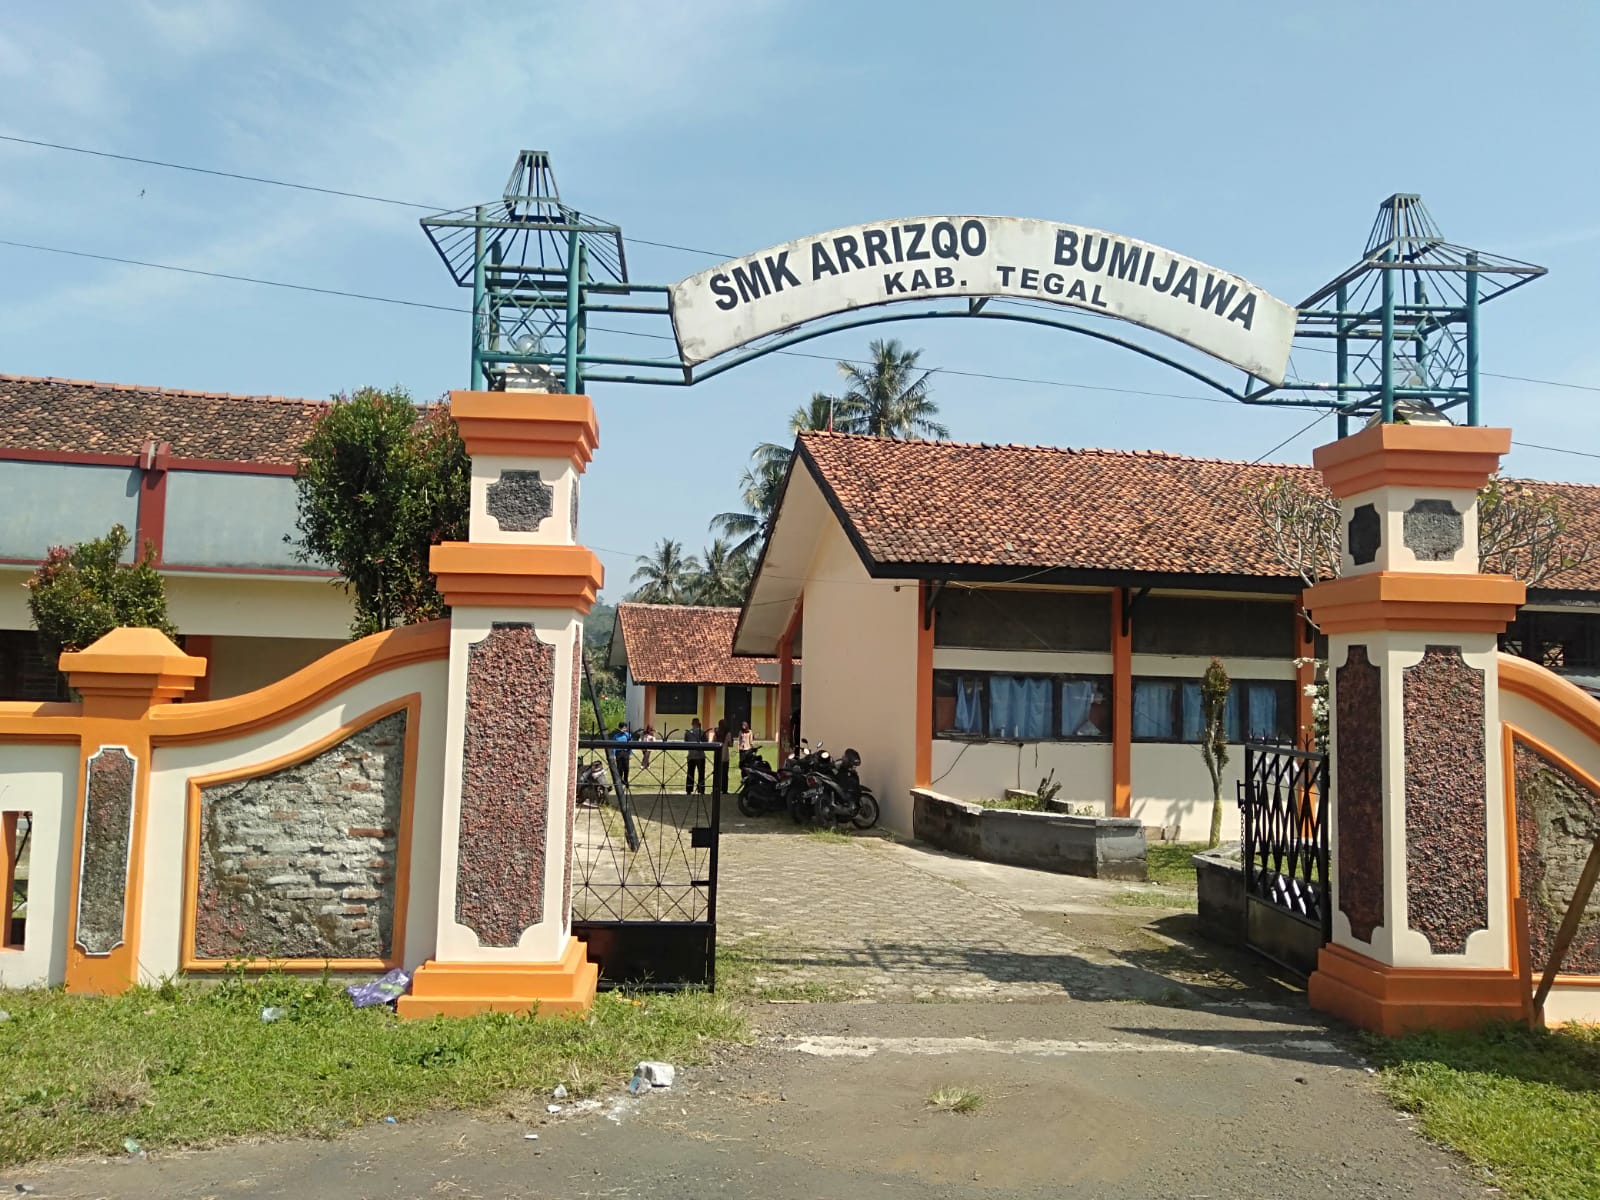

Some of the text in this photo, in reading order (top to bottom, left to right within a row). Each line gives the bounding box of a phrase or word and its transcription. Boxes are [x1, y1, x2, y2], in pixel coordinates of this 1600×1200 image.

[709, 219, 1257, 331] SMK ARRIZQO BUMIJAWA
[883, 265, 1107, 308] KAB. TEGAL
